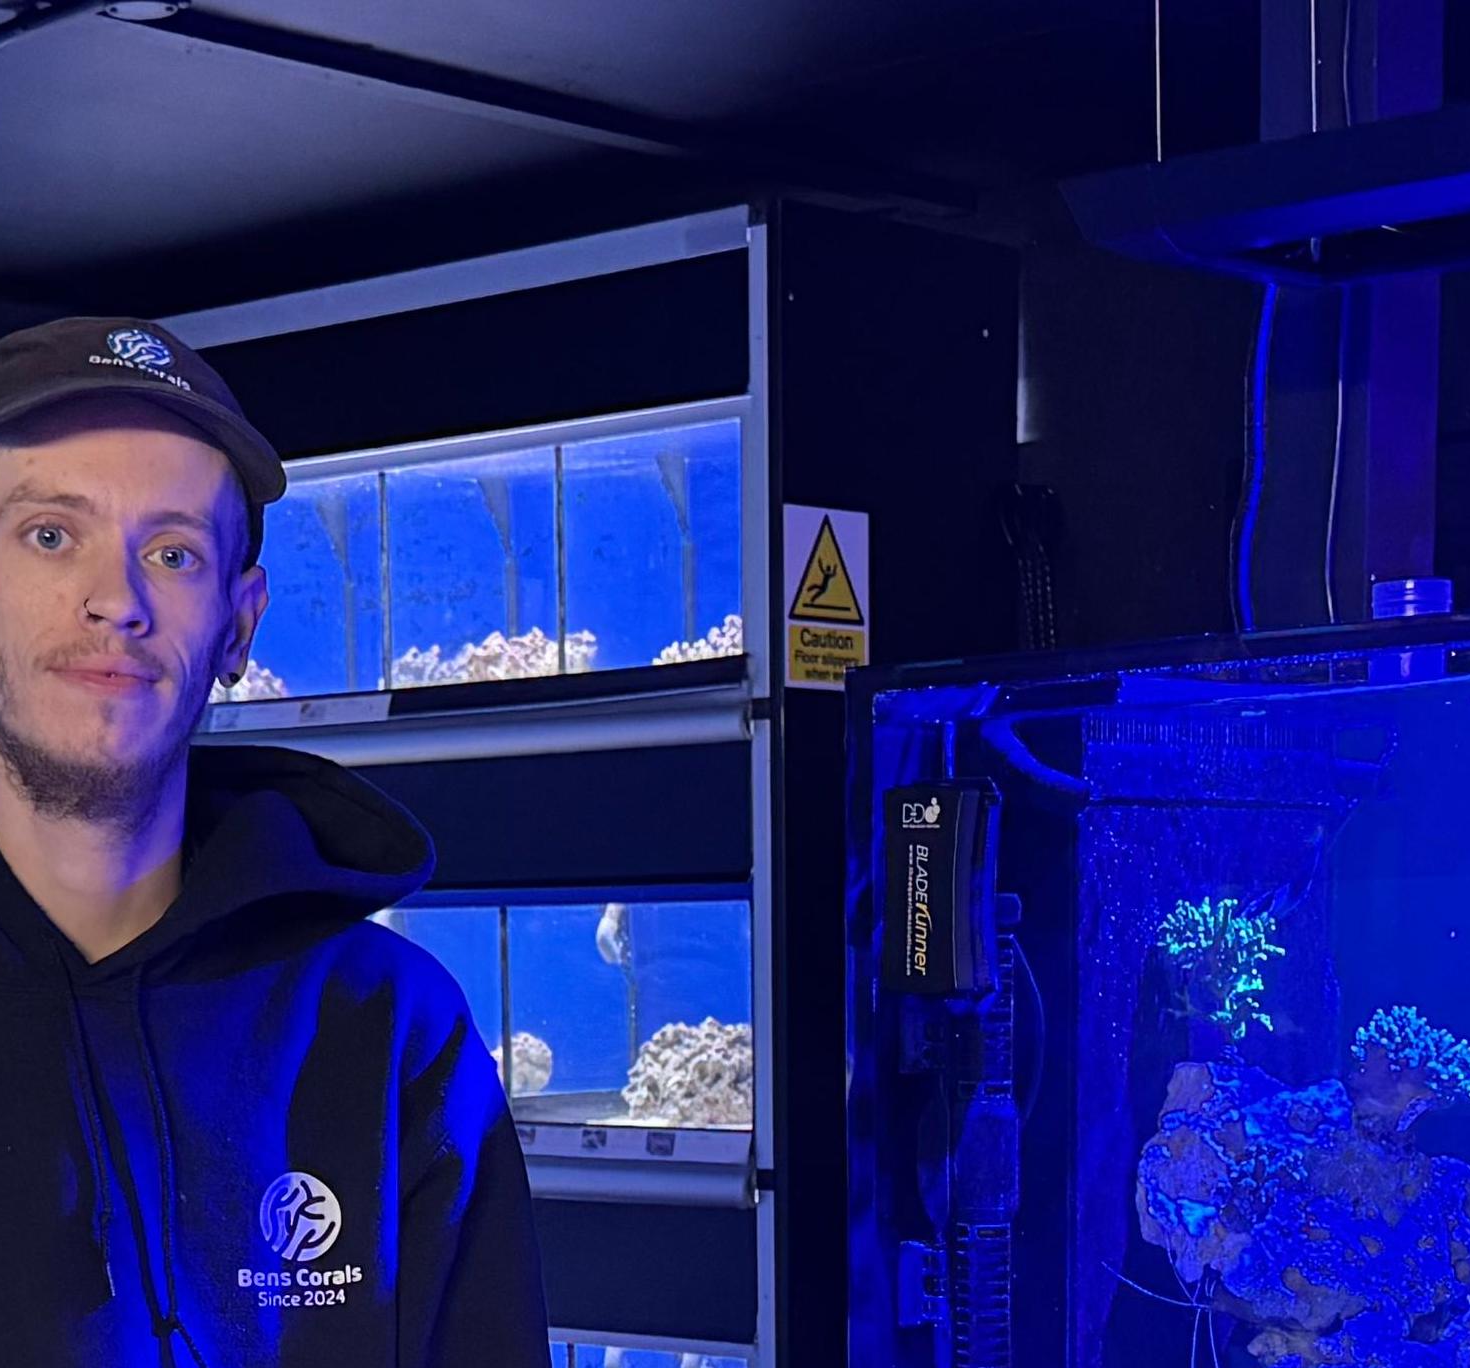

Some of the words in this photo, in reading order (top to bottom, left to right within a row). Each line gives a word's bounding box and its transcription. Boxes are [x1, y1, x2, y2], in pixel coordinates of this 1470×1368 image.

[800, 628, 854, 650] Caution
[237, 1268, 292, 1287] Bens
[295, 1264, 363, 1287] Corals
[258, 1291, 301, 1307] Since
[303, 1288, 346, 1306] 2024
